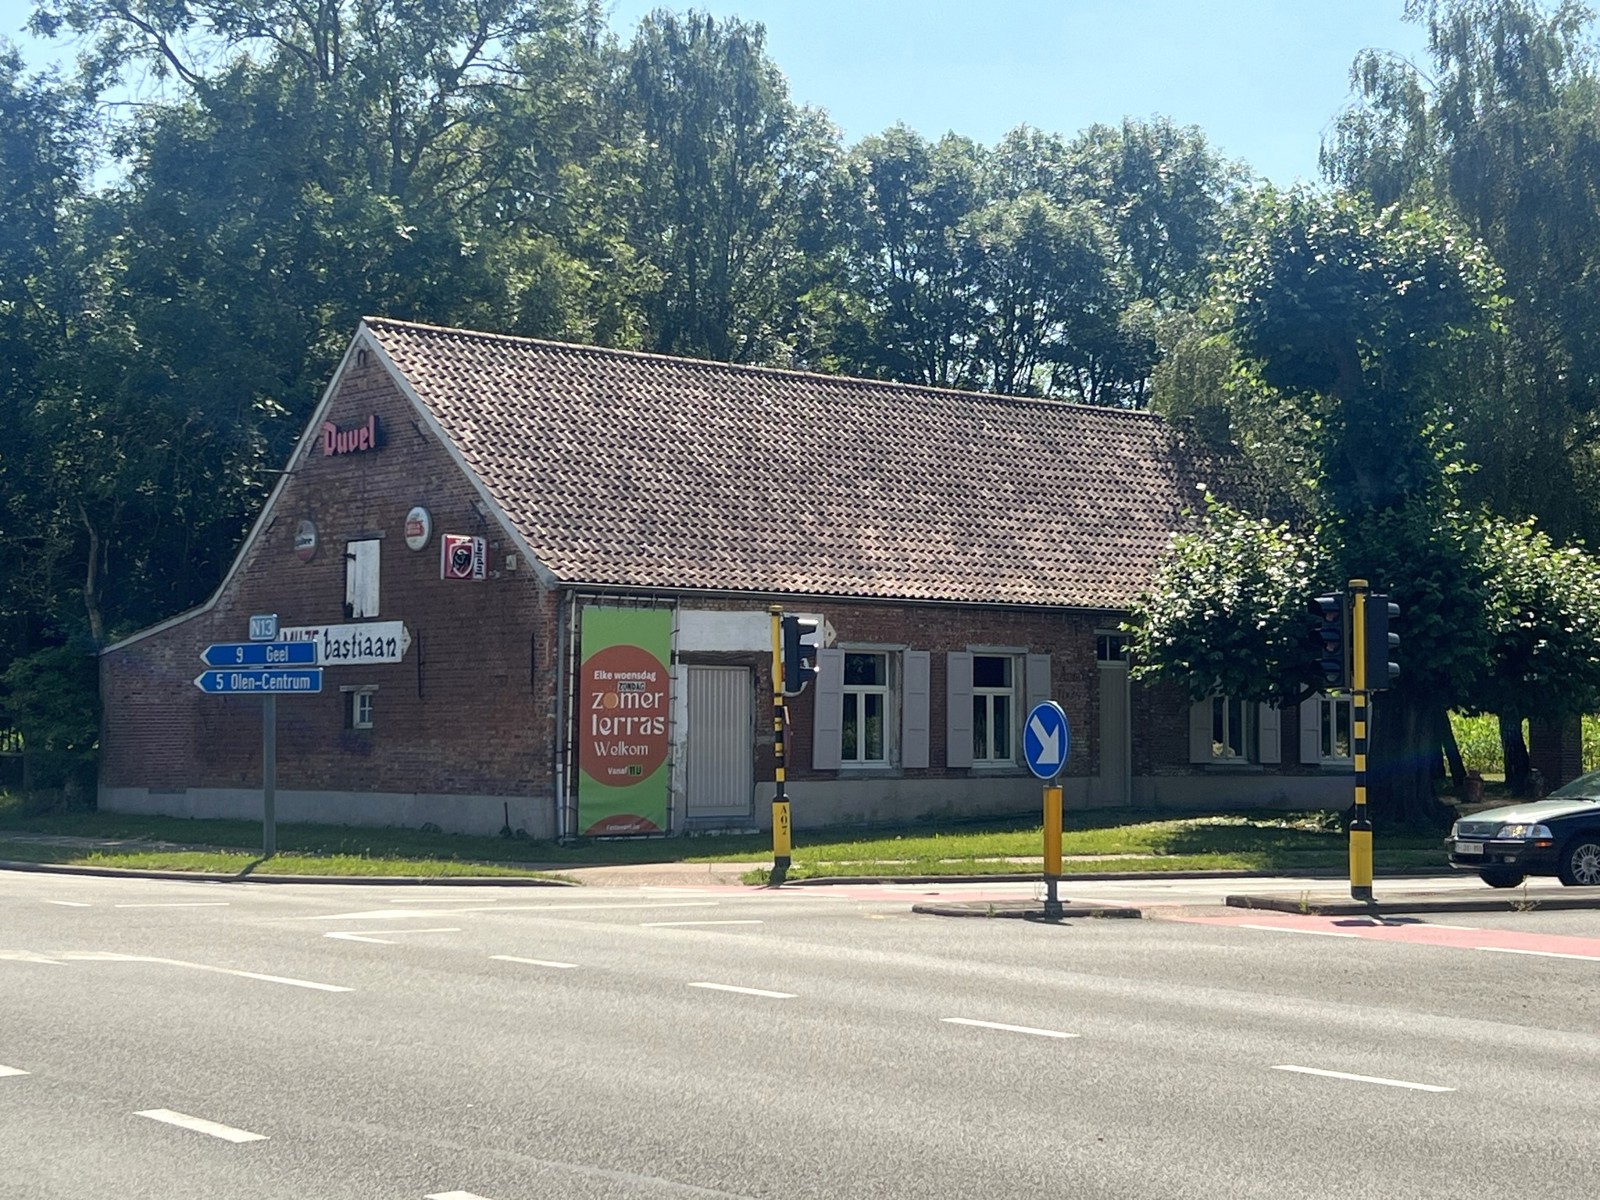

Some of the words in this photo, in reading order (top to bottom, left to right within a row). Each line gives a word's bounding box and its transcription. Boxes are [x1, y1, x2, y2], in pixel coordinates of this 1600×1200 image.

[323, 415, 375, 456] Duvel
[252, 619, 273, 636] N13
[323, 628, 397, 661] bastiaan
[236, 647, 244, 663] 9
[266, 646, 289, 662] Geel
[216, 674, 224, 690] 5
[231, 673, 310, 690] Olen-Centrum
[594, 670, 613, 680] Elke
[614, 670, 656, 682] woensdag
[592, 692, 664, 709] zomer
[594, 741, 648, 756] Welkom
